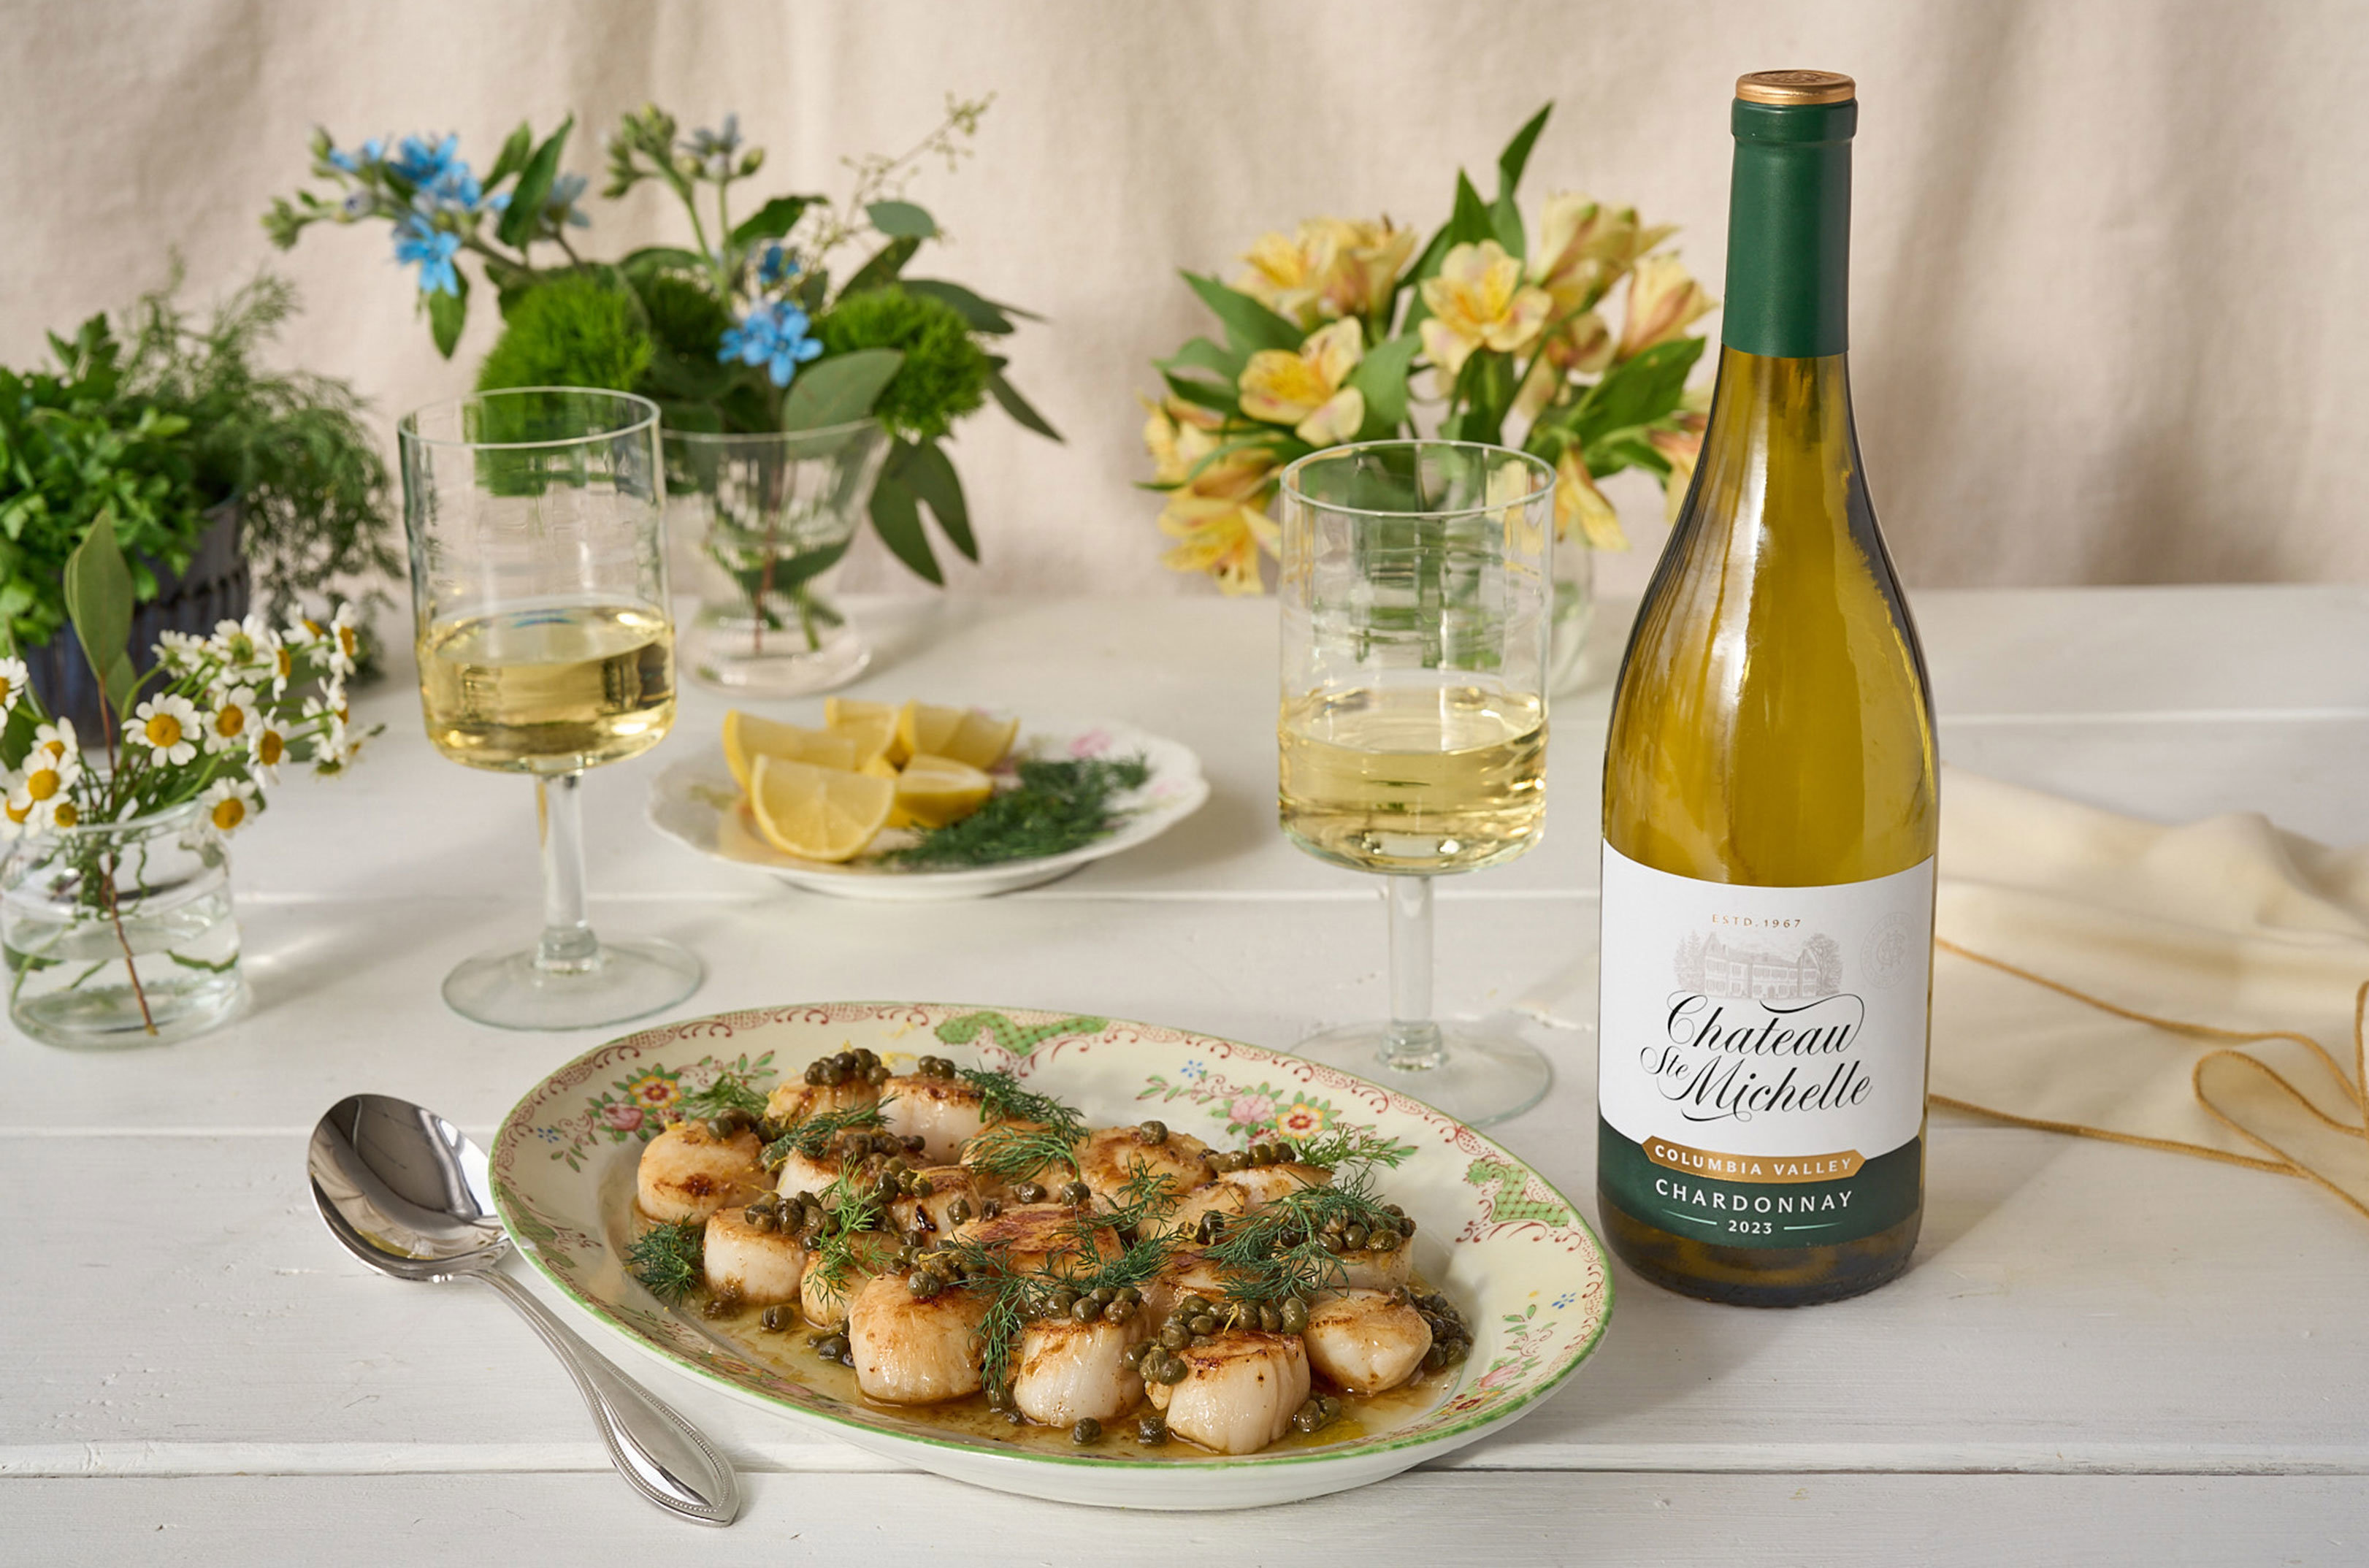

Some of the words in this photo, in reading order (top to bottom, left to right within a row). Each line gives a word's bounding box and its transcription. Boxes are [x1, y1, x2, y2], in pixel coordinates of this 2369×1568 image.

[1666, 990, 1864, 1056] Chateau
[1640, 1045, 1691, 1080] Ste
[1656, 1055, 1873, 1122] Michelle
[1654, 1144, 1762, 1176] COLUMBIA
[1774, 1158, 1852, 1176] VALLEY
[1655, 1178, 1853, 1214] CHARDONNAY
[1728, 1220, 1772, 1234] 2023
